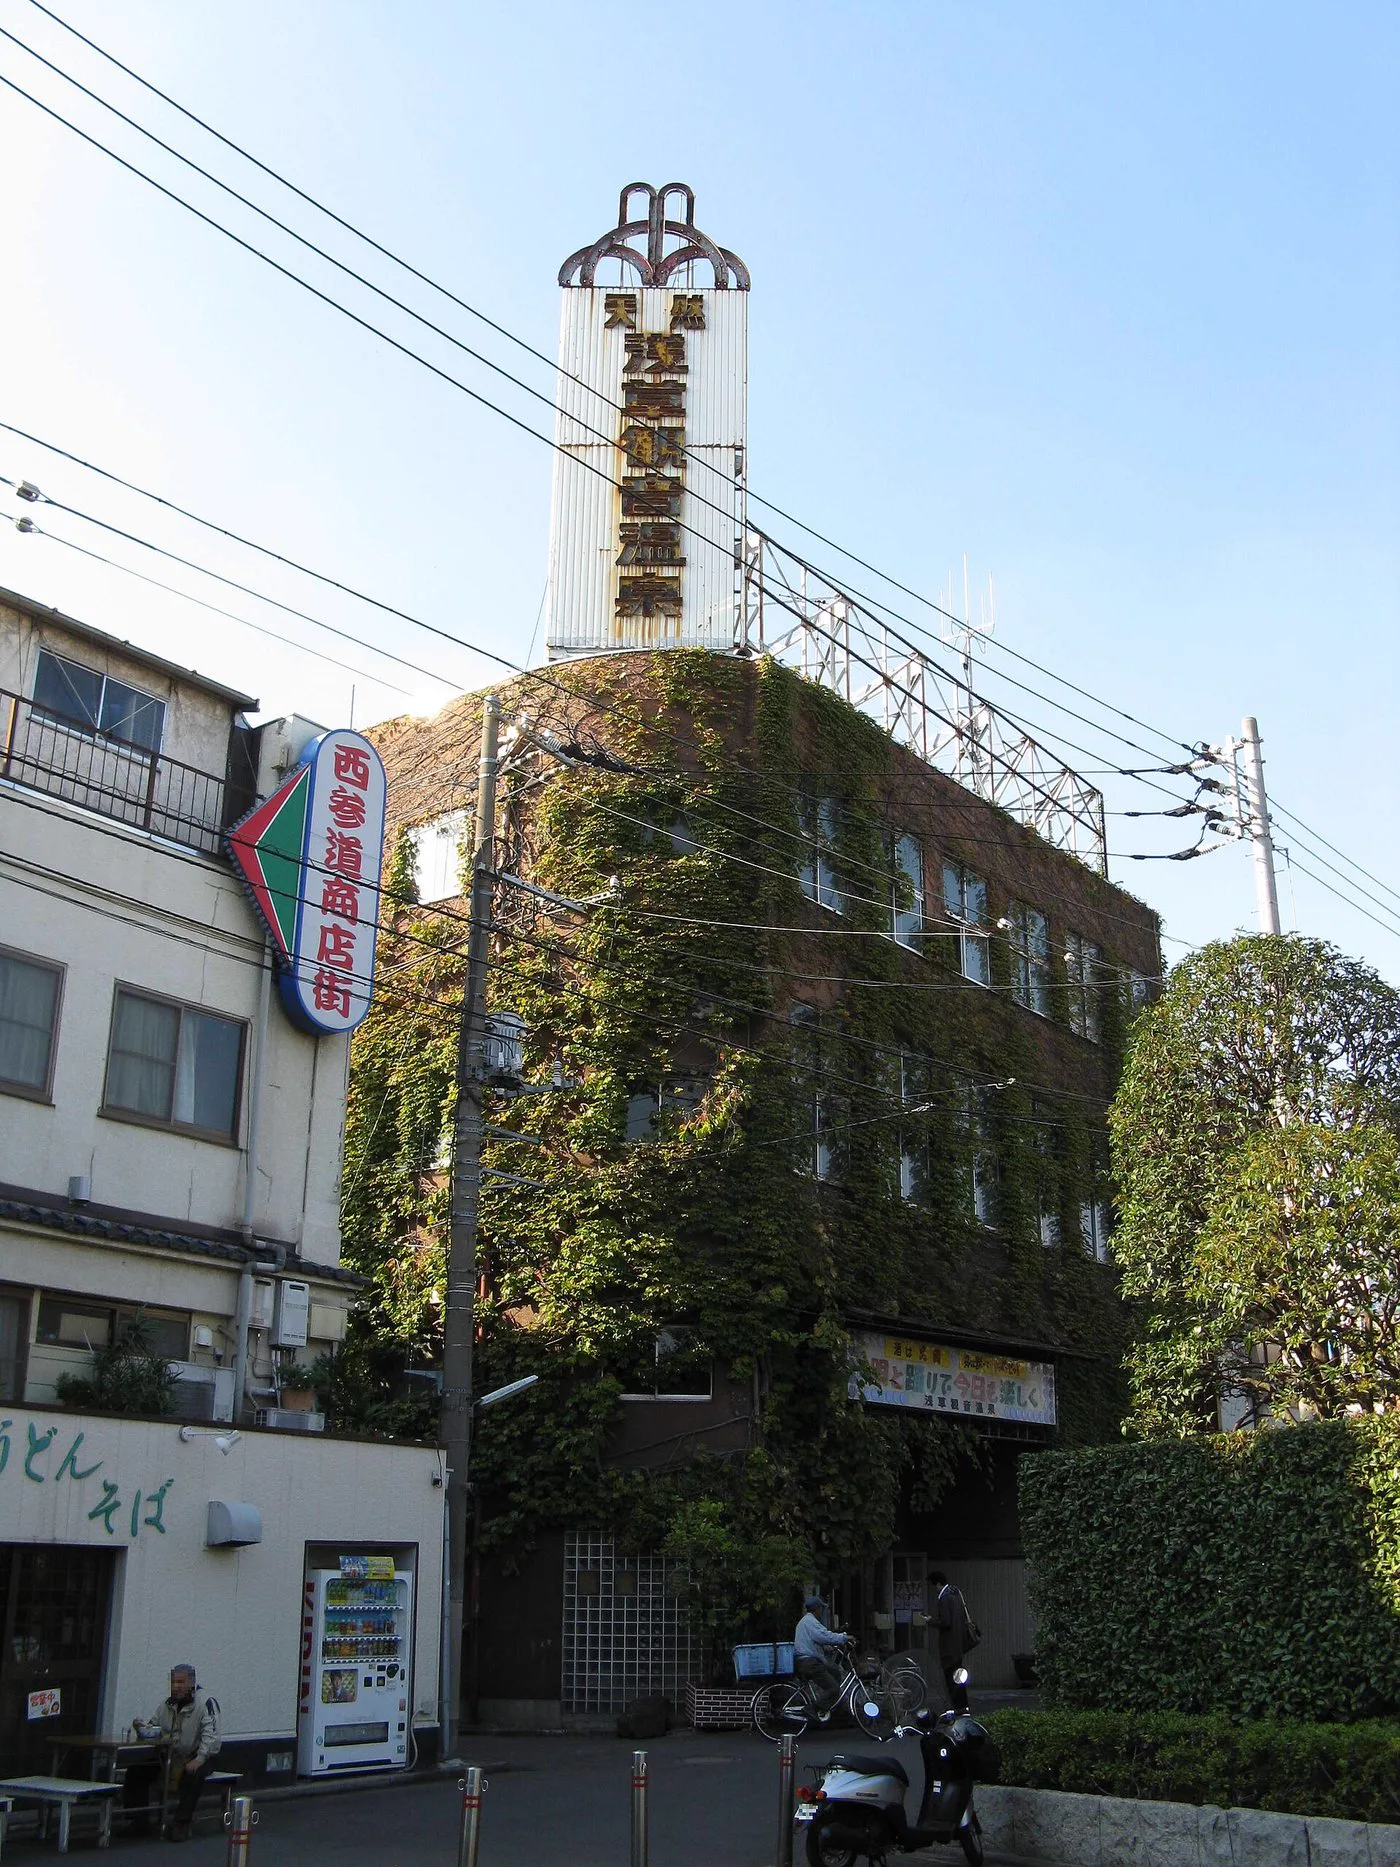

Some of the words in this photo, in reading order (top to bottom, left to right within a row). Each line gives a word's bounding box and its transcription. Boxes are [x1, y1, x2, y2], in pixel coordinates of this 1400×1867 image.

[604, 293, 706, 330] 天然
[314, 743, 371, 1020] 西参道商店街
[924, 1394, 995, 1415] 浅草観音温泉
[88, 1478, 175, 1538] そば
